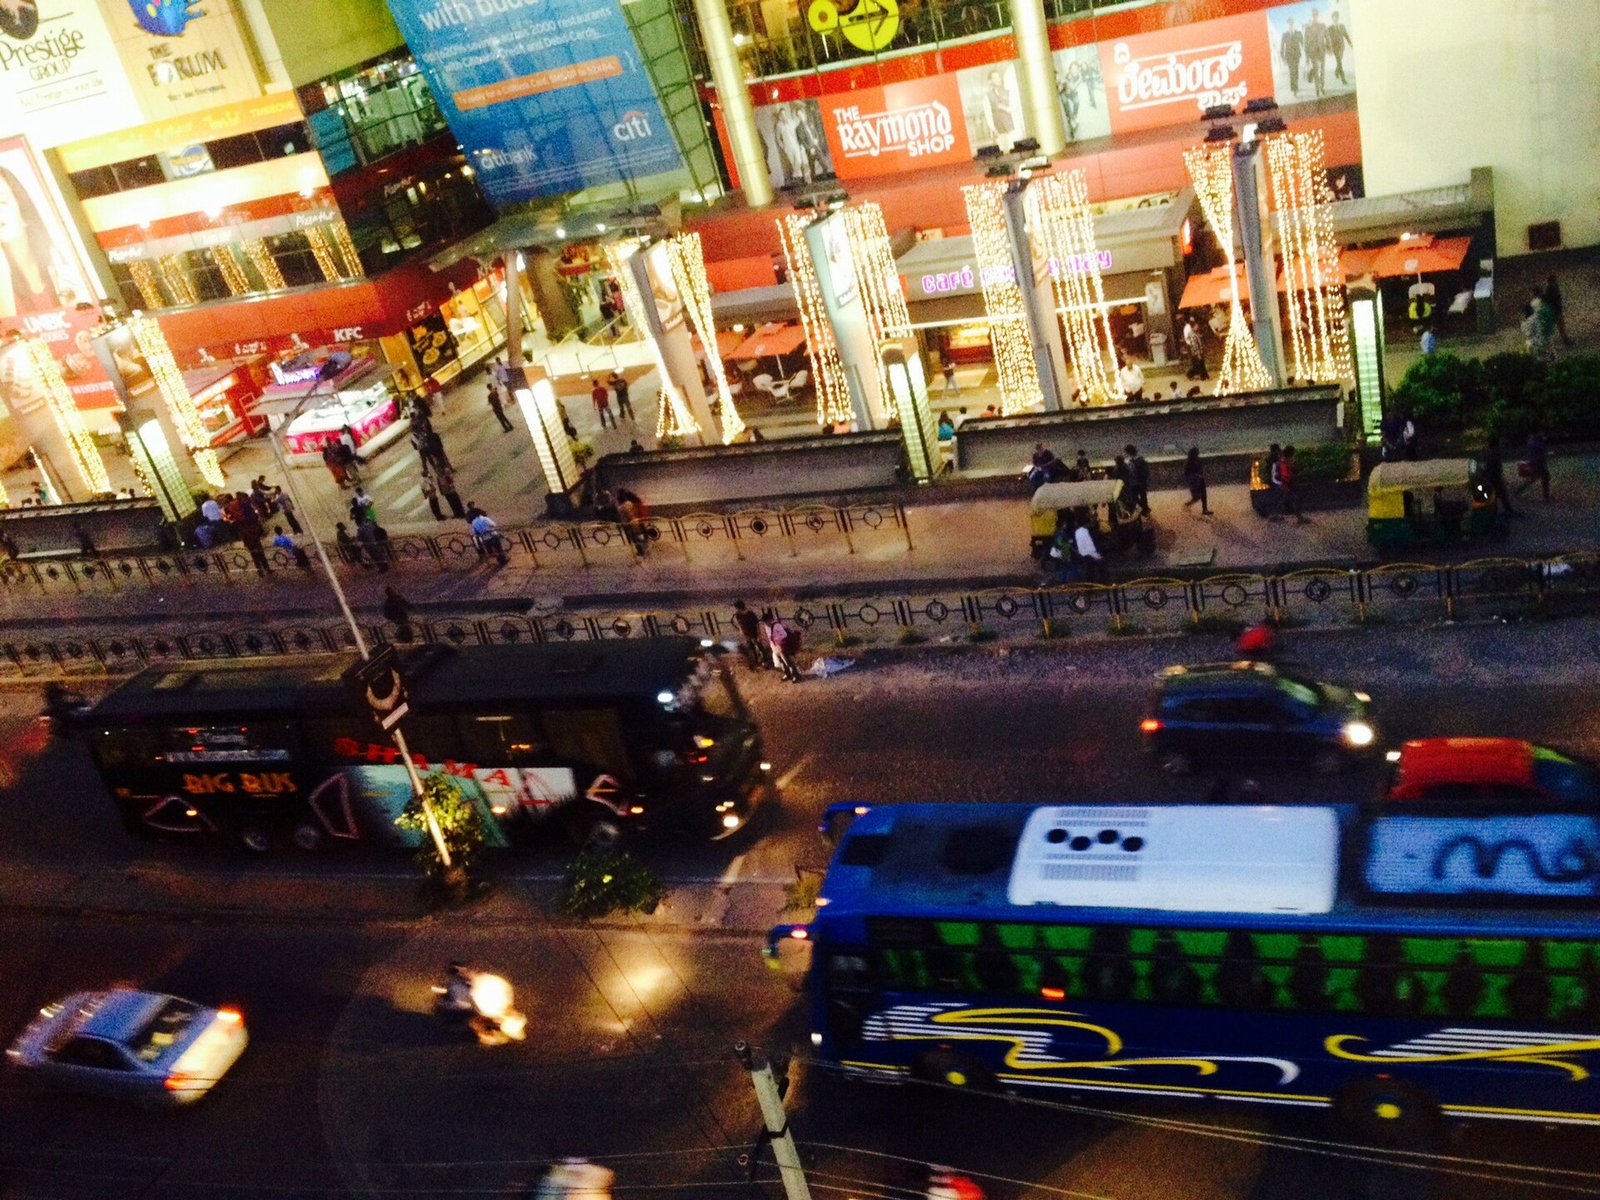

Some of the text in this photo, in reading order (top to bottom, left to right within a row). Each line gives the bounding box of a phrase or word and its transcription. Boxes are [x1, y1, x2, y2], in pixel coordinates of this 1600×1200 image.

[419, 0, 474, 32] with
[530, 20, 556, 35] 2000
[0, 27, 86, 71] Prestige
[29, 59, 71, 82] GROUP
[833, 105, 861, 123] THE
[613, 114, 653, 142] citi
[837, 101, 953, 156] Raymond
[907, 133, 955, 157] SHOP
[480, 145, 538, 171] citibank
[333, 326, 364, 342] KFC
[182, 772, 236, 794] BIG
